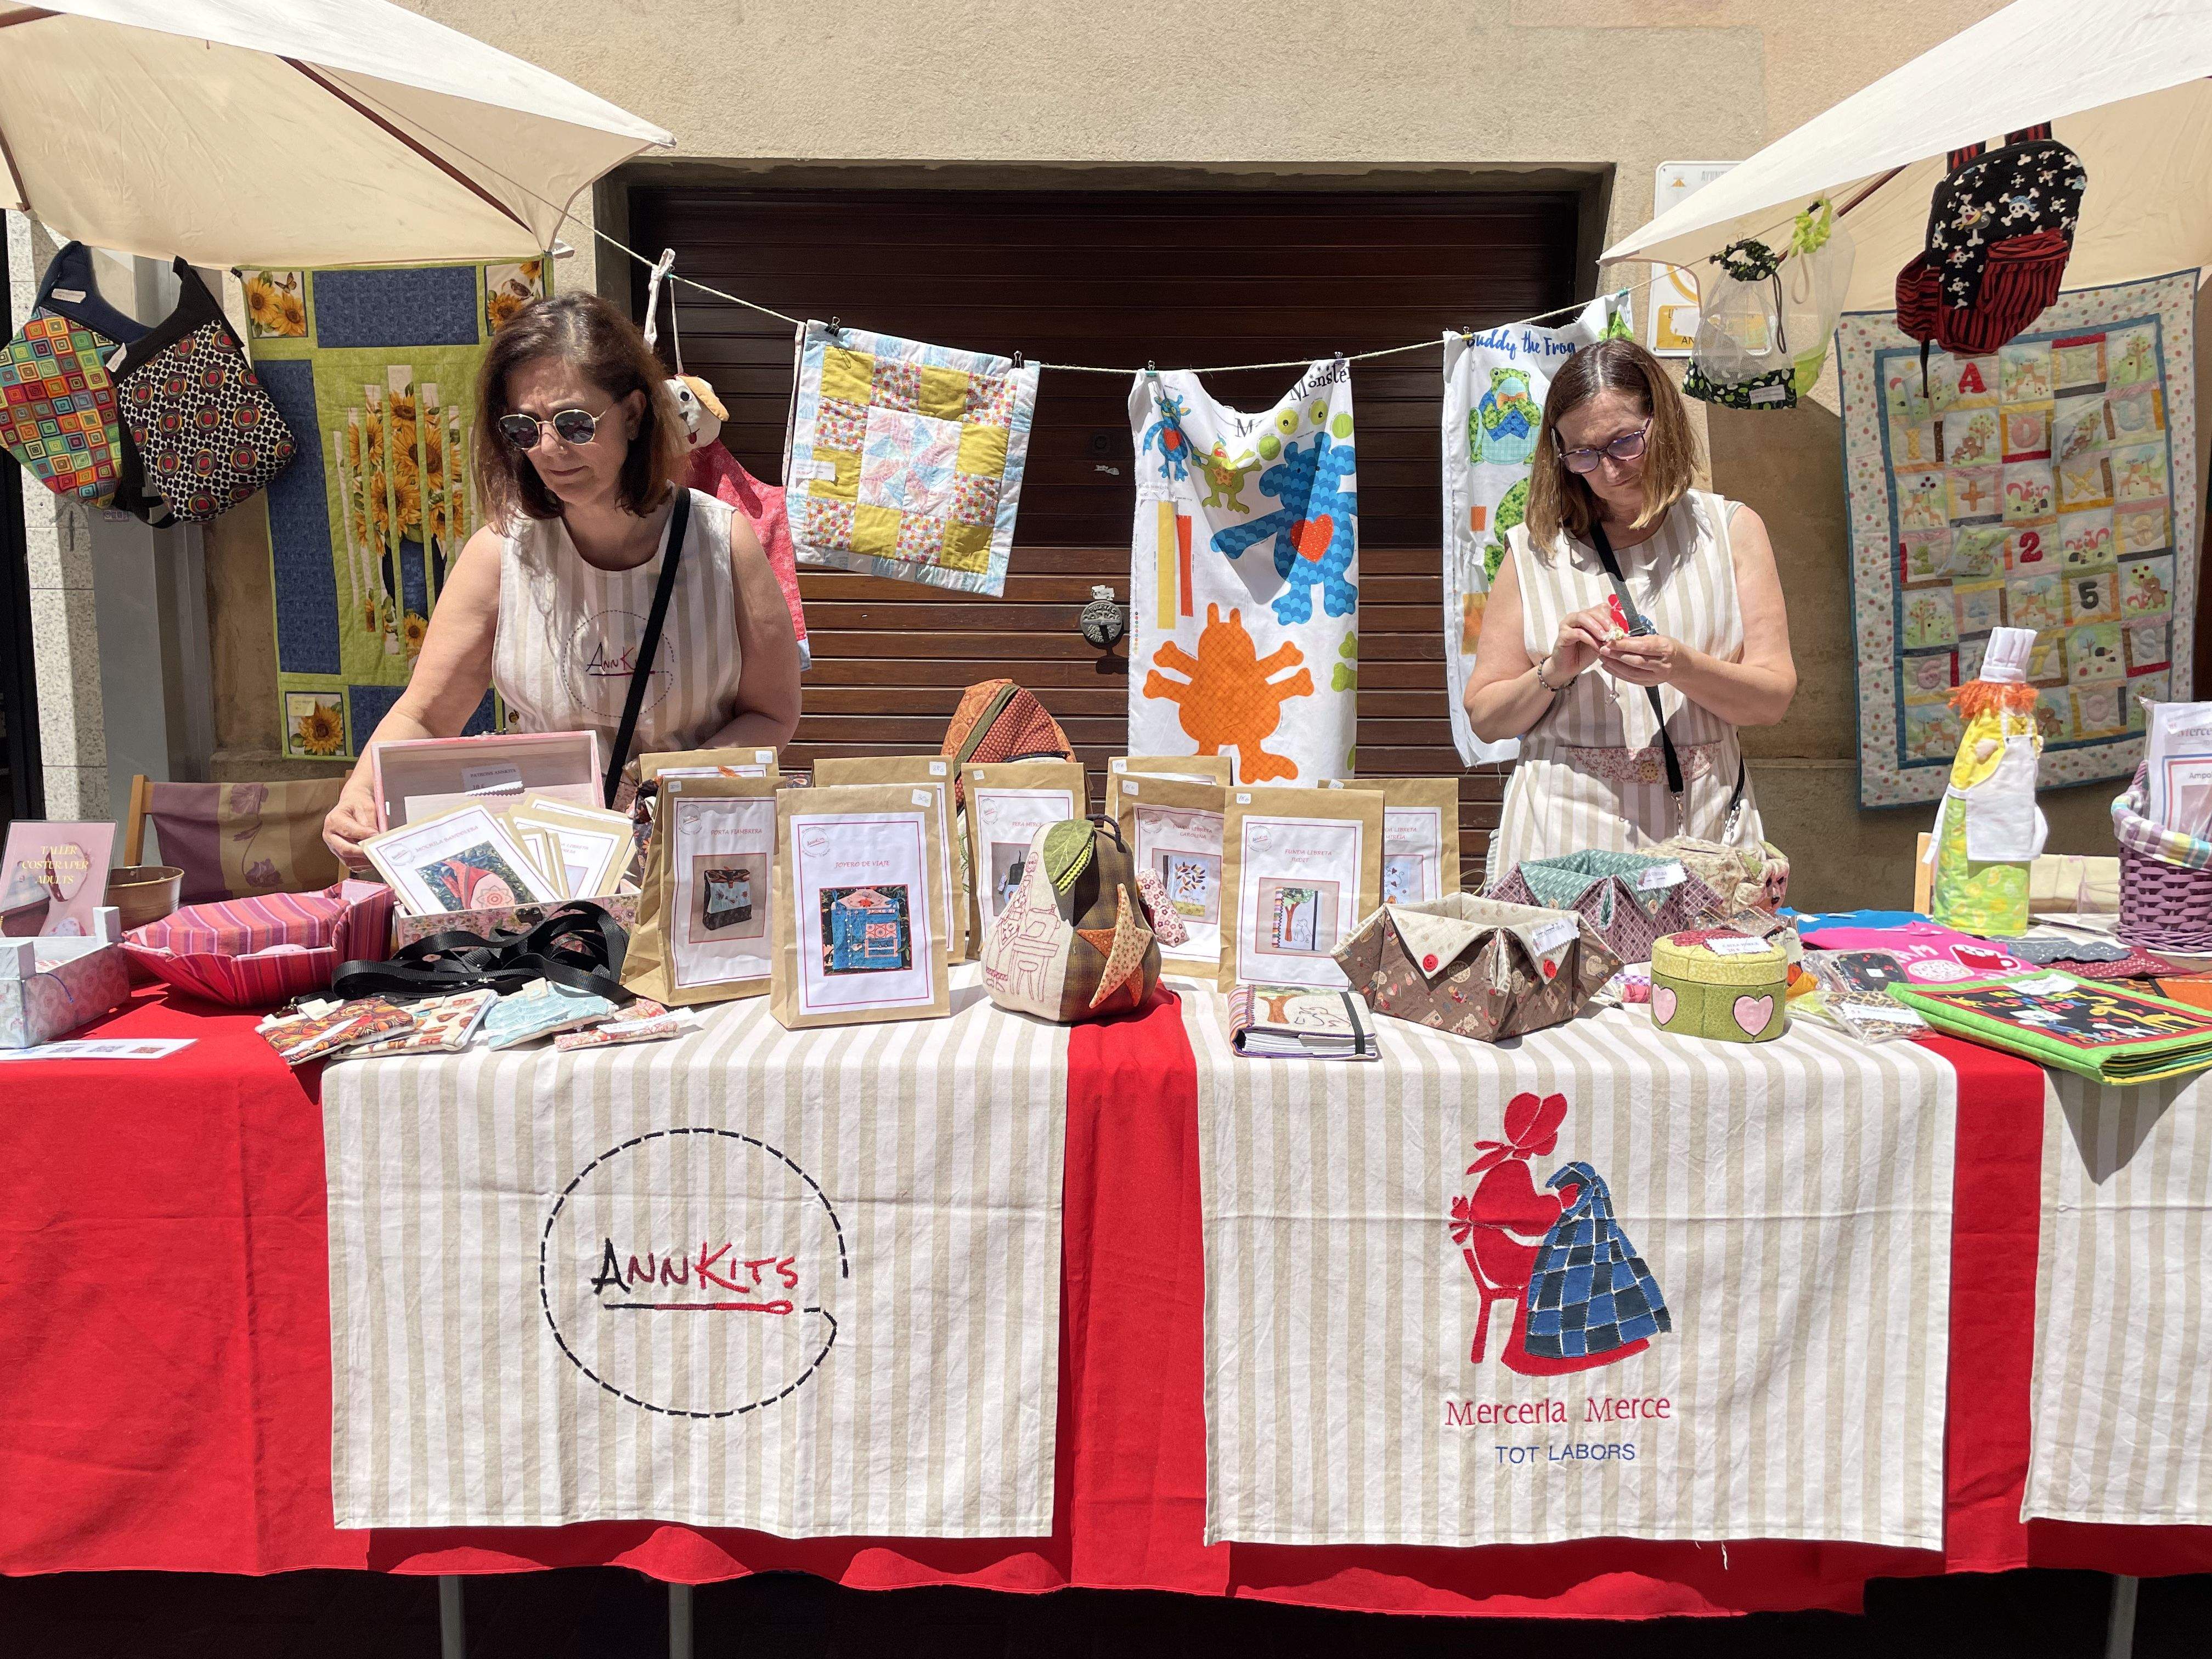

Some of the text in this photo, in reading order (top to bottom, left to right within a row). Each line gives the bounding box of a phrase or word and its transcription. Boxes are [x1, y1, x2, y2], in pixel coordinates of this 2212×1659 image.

[1521, 330, 1541, 354] the
[1289, 360, 1351, 402] Monste
[585, 642, 636, 672] ANNK
[41, 845, 77, 855] TALLER
[22, 860, 89, 870] COSTURA PER
[834, 861, 860, 869] JOYERO
[37, 875, 74, 884] ADULTS
[1584, 1396, 1671, 1422] Merce
[1495, 1443, 1635, 1466] TOT LABORS
